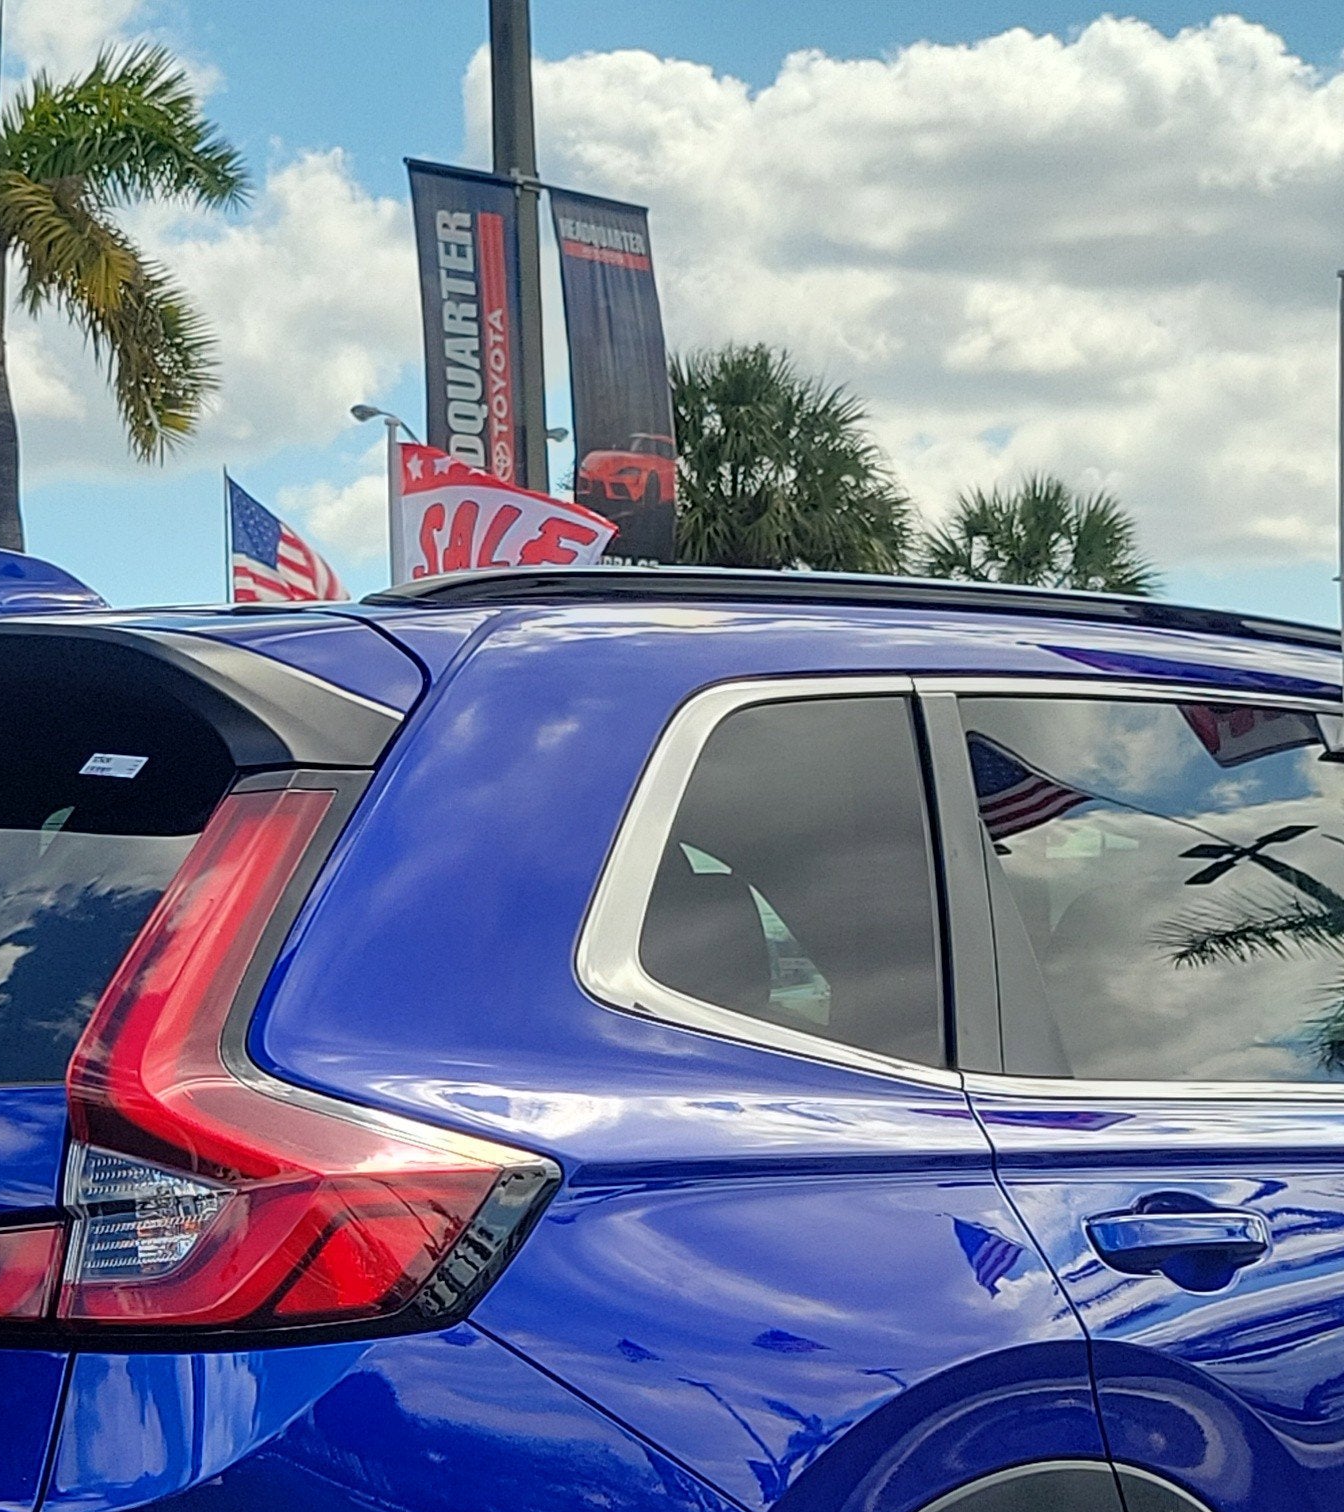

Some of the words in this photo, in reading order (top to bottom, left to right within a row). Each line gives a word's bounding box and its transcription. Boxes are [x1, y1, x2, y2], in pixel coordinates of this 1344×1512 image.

[436, 210, 488, 468] DQUARTER
[488, 308, 510, 435] TOYOTA
[412, 500, 598, 579] SALE
